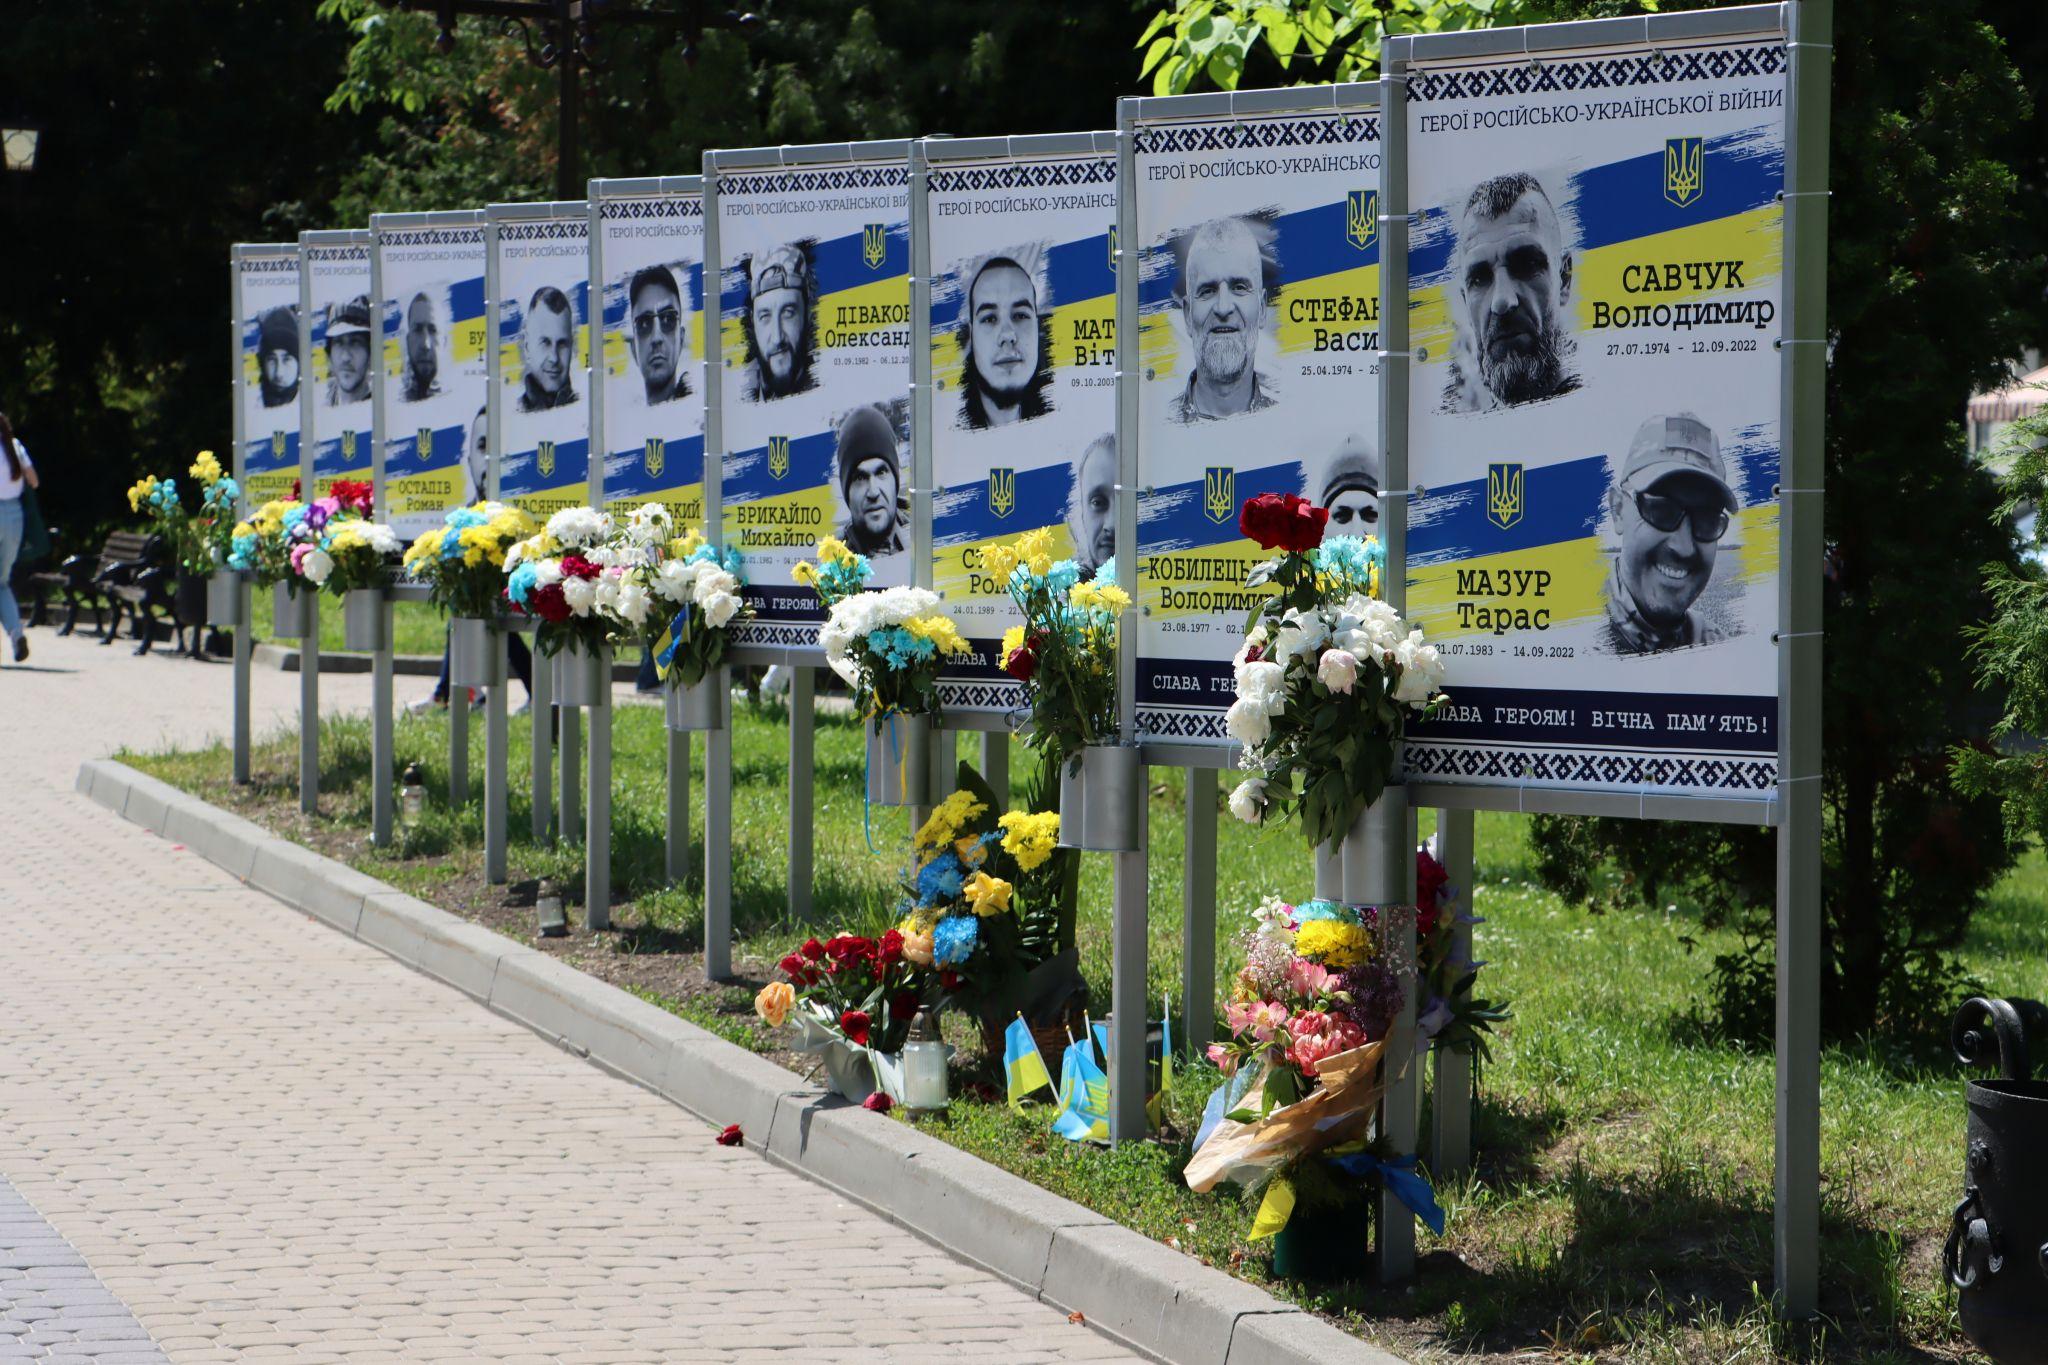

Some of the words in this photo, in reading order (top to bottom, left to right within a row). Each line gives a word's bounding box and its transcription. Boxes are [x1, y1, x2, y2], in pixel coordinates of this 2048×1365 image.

[1420, 109, 1469, 133] ГЕРОЇ
[1473, 91, 1713, 129] РОСІЙСЬКО-УКРАЇНСЬКОЇ
[1719, 88, 1783, 111] ВІЙНИ
[1148, 161, 1186, 181] ГЕРОЇ
[1190, 153, 1380, 179] РОСІЙСЬКО-УКРАЇНСЬКО
[727, 203, 754, 216] ГЕРОЇ
[757, 195, 890, 215] РОСІЙСЬКО-УКРАЇНСЬКОЇ
[938, 199, 972, 216] ГЕРОЇ
[1622, 261, 1745, 293] САВЧУК
[1592, 300, 1775, 332] Володимир
[1073, 318, 1116, 340] МАТ
[1074, 342, 1115, 366] Віт
[1606, 342, 1670, 356] 27.07.1974
[1691, 340, 1757, 353] 12.09.2022
[1301, 365, 1353, 376] 25.04.1974
[398, 480, 452, 495] ОСТАПІВ
[406, 496, 444, 511] Роман
[737, 502, 822, 525] БРИКАЙЛО
[741, 527, 816, 547] Михайло
[1456, 569, 1551, 597] МАЗУР
[771, 597, 819, 611] ГЕРОЯМ!
[1161, 622, 1210, 633] 23.08.1977
[1456, 602, 1550, 636] Тарас
[1513, 645, 1574, 658] 14.09.2022
[1152, 674, 1201, 691] СЛАВА
[1430, 705, 1483, 723] ЛАВА
[1494, 707, 1575, 727] ГЕРОЯМ!
[1592, 711, 1655, 730] ВІЧНА
[1666, 713, 1768, 734] ПАМ'ЯТЬ!
